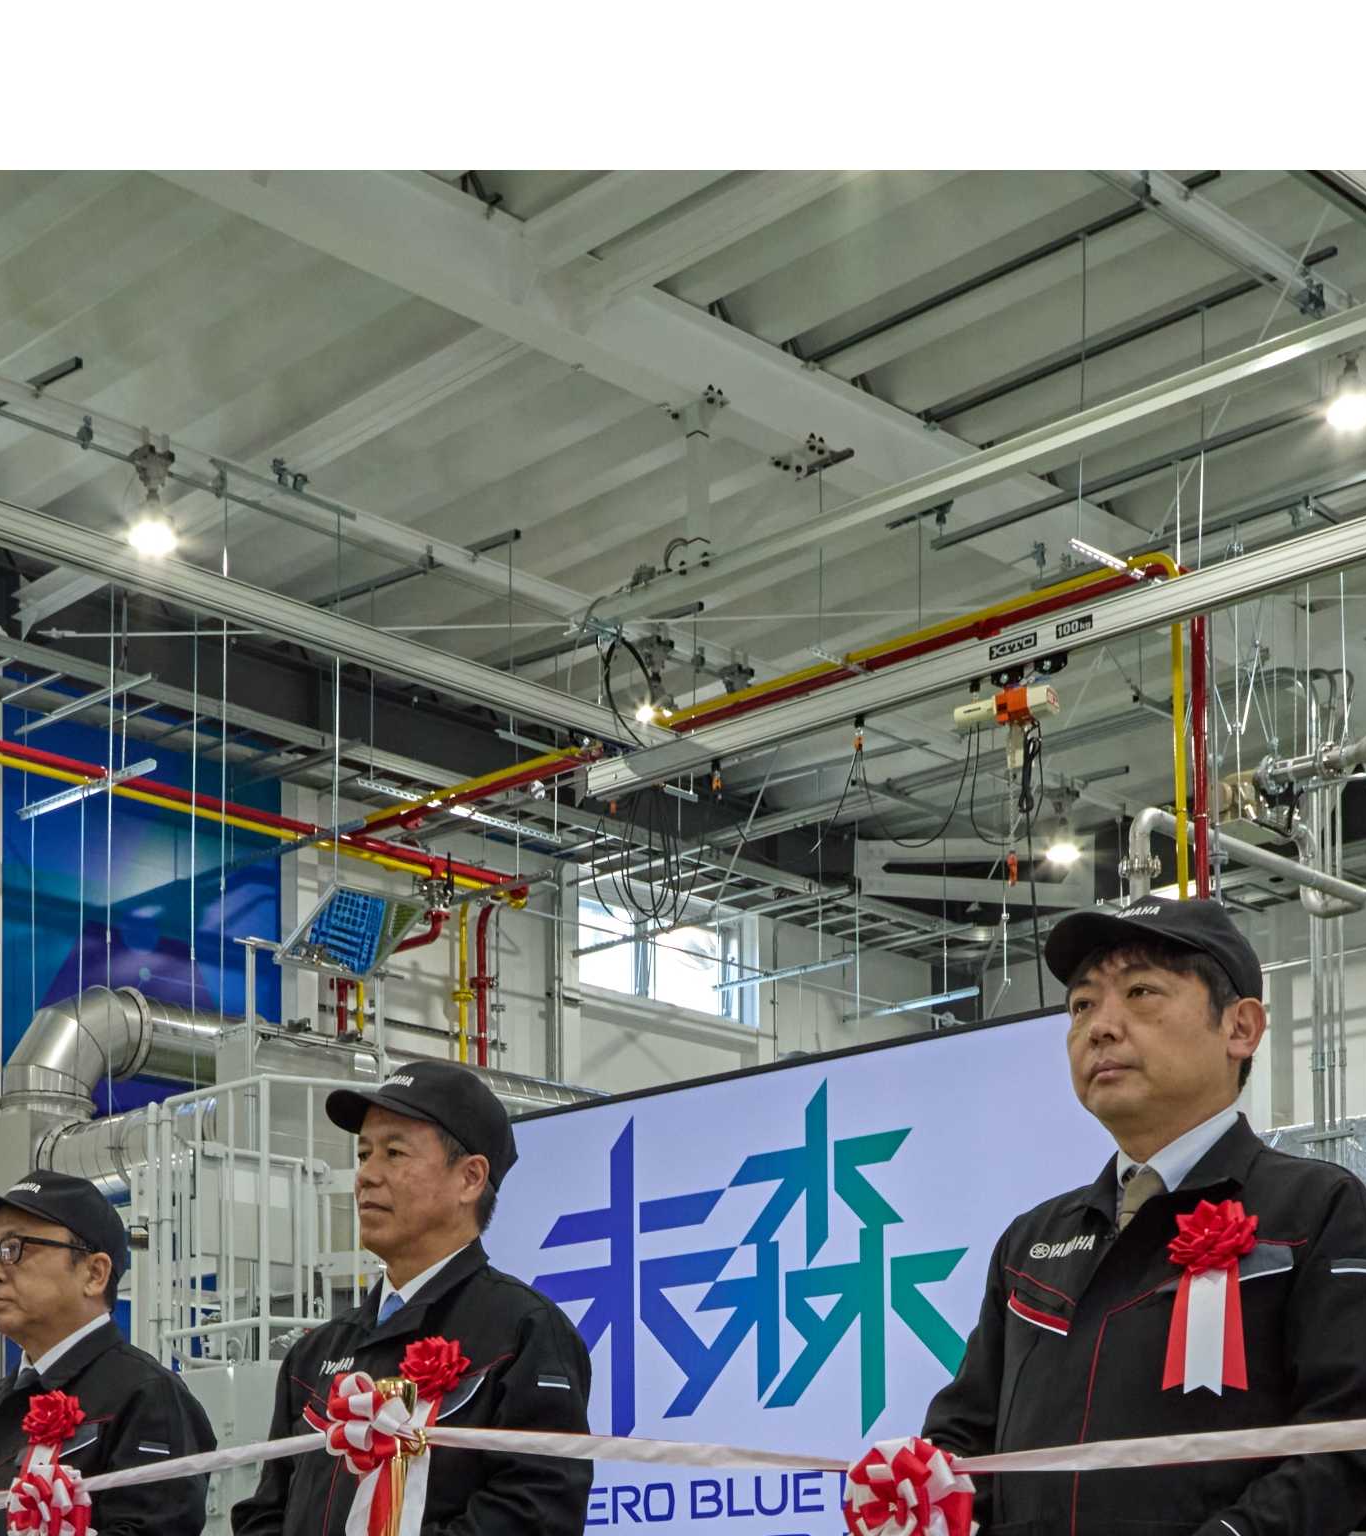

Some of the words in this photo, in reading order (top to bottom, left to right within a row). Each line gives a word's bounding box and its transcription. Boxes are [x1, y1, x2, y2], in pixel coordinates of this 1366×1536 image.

[990, 635, 1036, 658] KITO
[585, 1482, 676, 1526] ERO
[690, 1471, 825, 1520] BLUE
